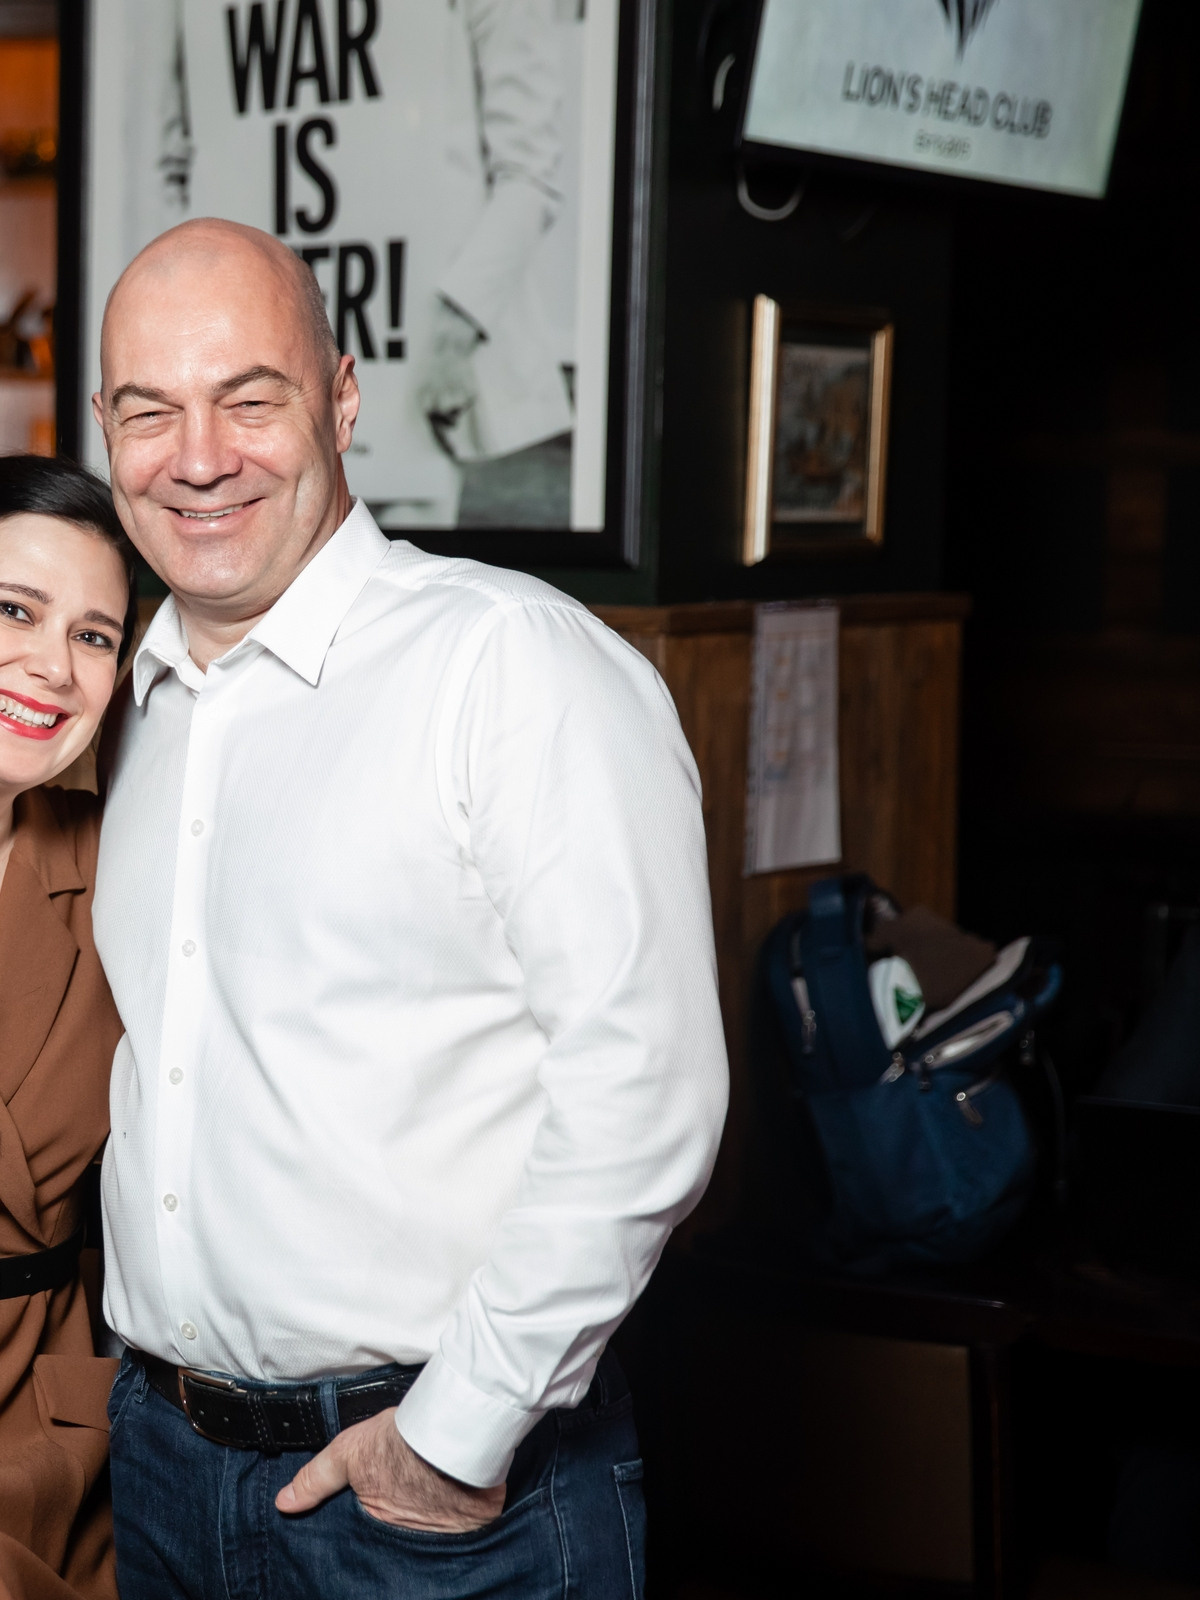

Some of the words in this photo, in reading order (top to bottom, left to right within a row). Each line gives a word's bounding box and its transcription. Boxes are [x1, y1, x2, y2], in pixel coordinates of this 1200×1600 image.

[227, 0, 383, 115] WAR
[921, 77, 991, 128] HEAD
[990, 91, 1054, 139] CLUB
[272, 117, 337, 237] IS
